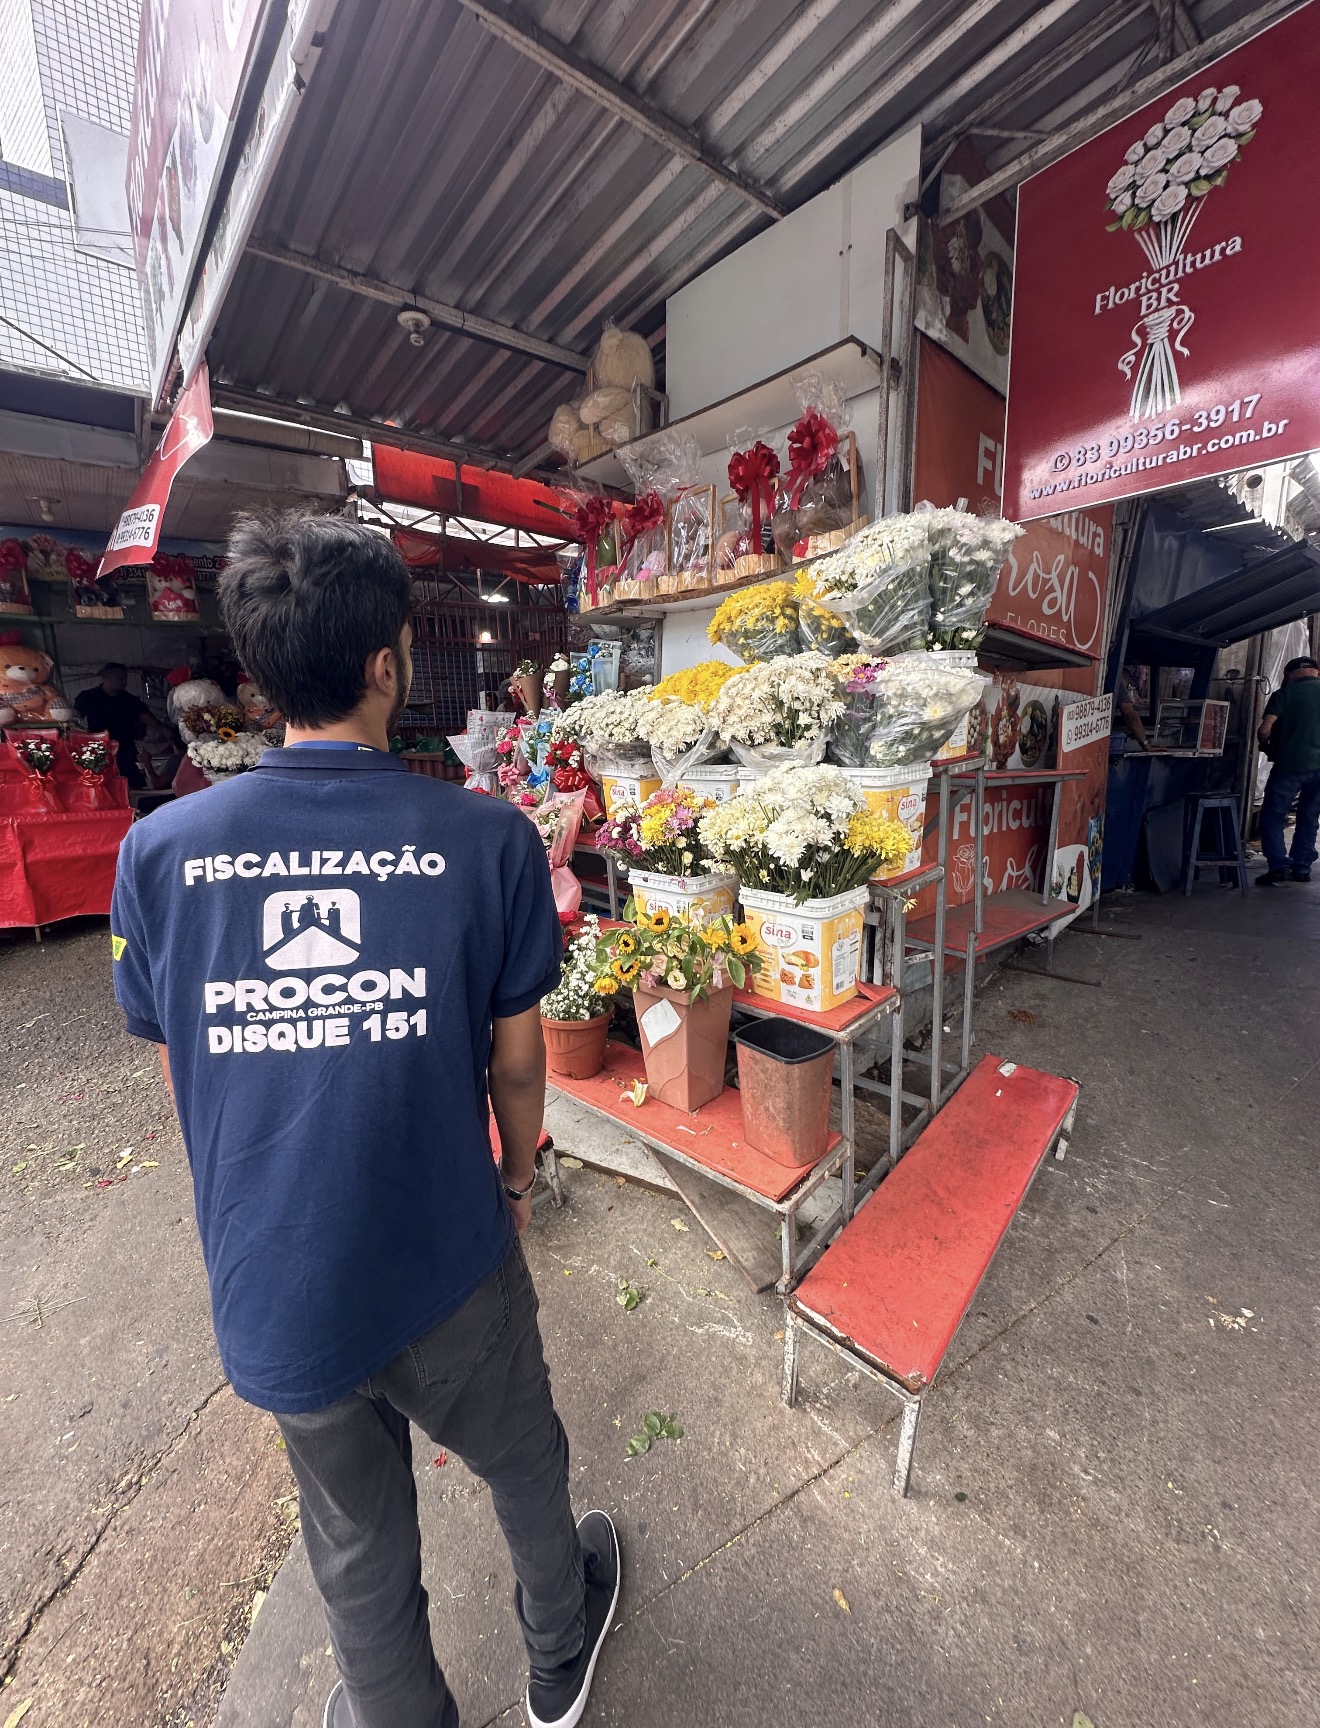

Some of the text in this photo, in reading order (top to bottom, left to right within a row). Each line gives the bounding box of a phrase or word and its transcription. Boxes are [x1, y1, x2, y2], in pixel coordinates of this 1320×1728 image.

[1094, 235, 1243, 316] Floricultura
[1139, 282, 1181, 317] BR
[1073, 393, 1262, 468] 83 99356-3917
[1028, 418, 1290, 501] www.floriculturabr.com.br
[900, 798, 917, 811] sina
[184, 844, 446, 886] FISCALIZAÇÃO
[764, 925, 792, 940] sina
[204, 967, 427, 1014] PROCON
[246, 1001, 384, 1021] CAMPINA GRANDE-PB
[208, 1008, 428, 1054] DISQUE 151
